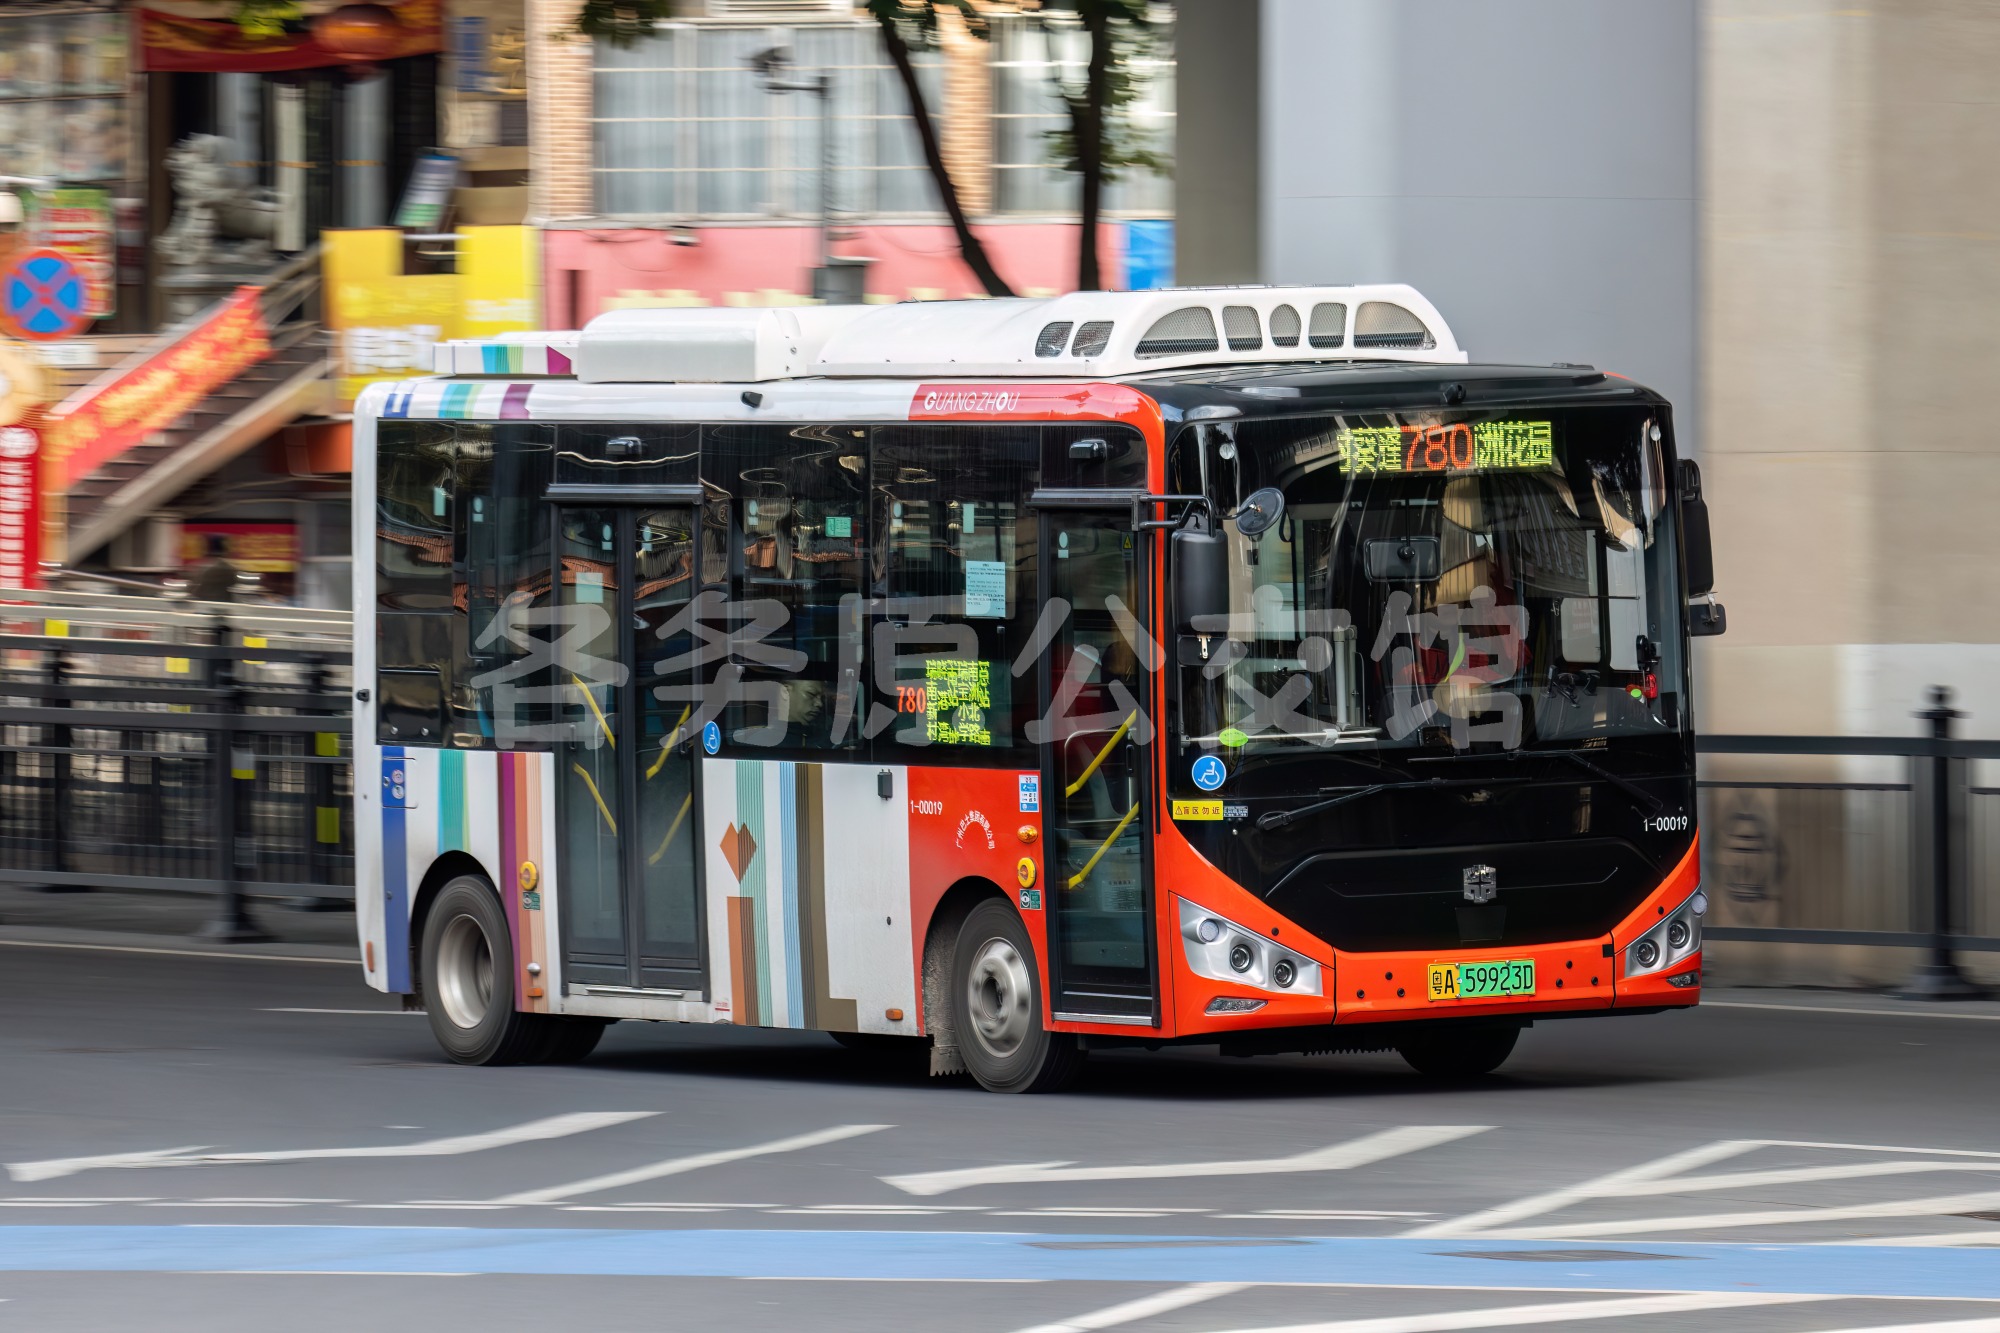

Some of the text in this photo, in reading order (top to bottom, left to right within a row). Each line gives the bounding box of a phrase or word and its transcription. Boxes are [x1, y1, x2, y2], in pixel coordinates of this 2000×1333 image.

[924, 391, 1021, 411] GUANGZHOU
[1401, 423, 1473, 471] 780
[896, 686, 926, 713] 780
[910, 800, 943, 815] 1-00019
[1183, 806, 1220, 815] 盲区勿近
[1643, 816, 1688, 832] 1-00019
